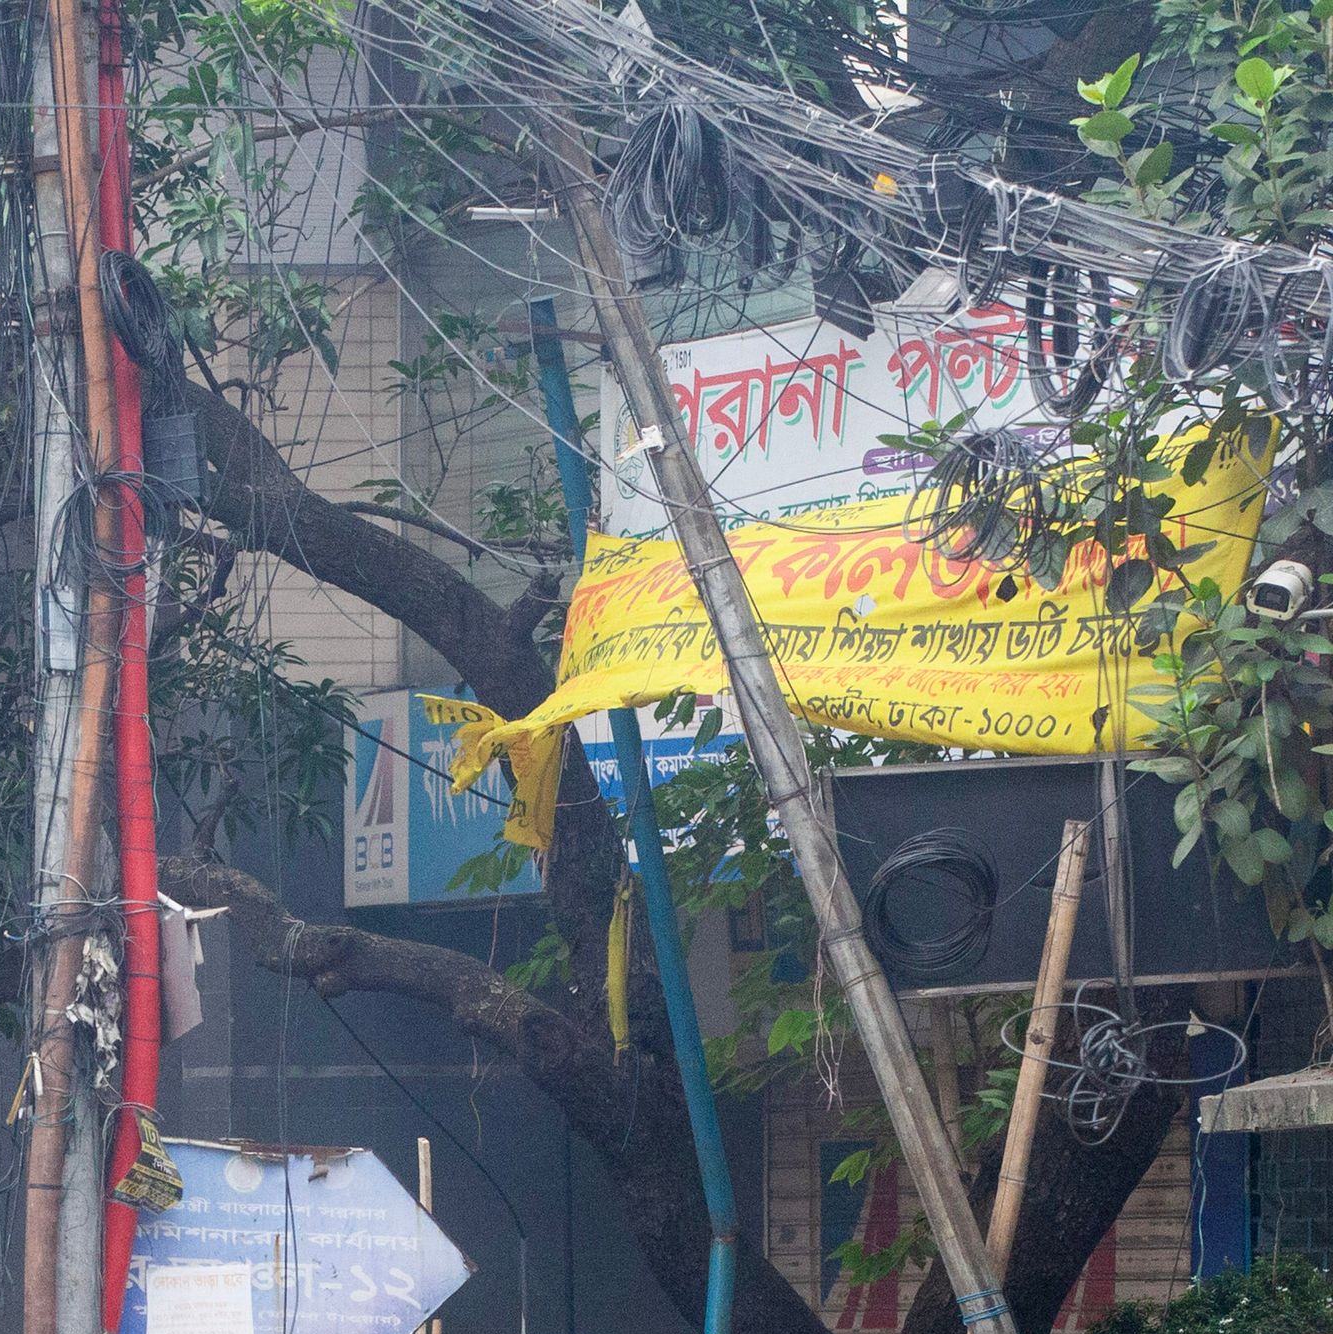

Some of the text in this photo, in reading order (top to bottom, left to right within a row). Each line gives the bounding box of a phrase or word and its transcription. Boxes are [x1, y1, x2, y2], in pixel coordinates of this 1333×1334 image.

[823, 606, 907, 663] শিক্ষা
[910, 618, 1003, 665] শাখায়
[1006, 600, 1069, 660] ভর্তি
[354, 831, 394, 873] BCB
